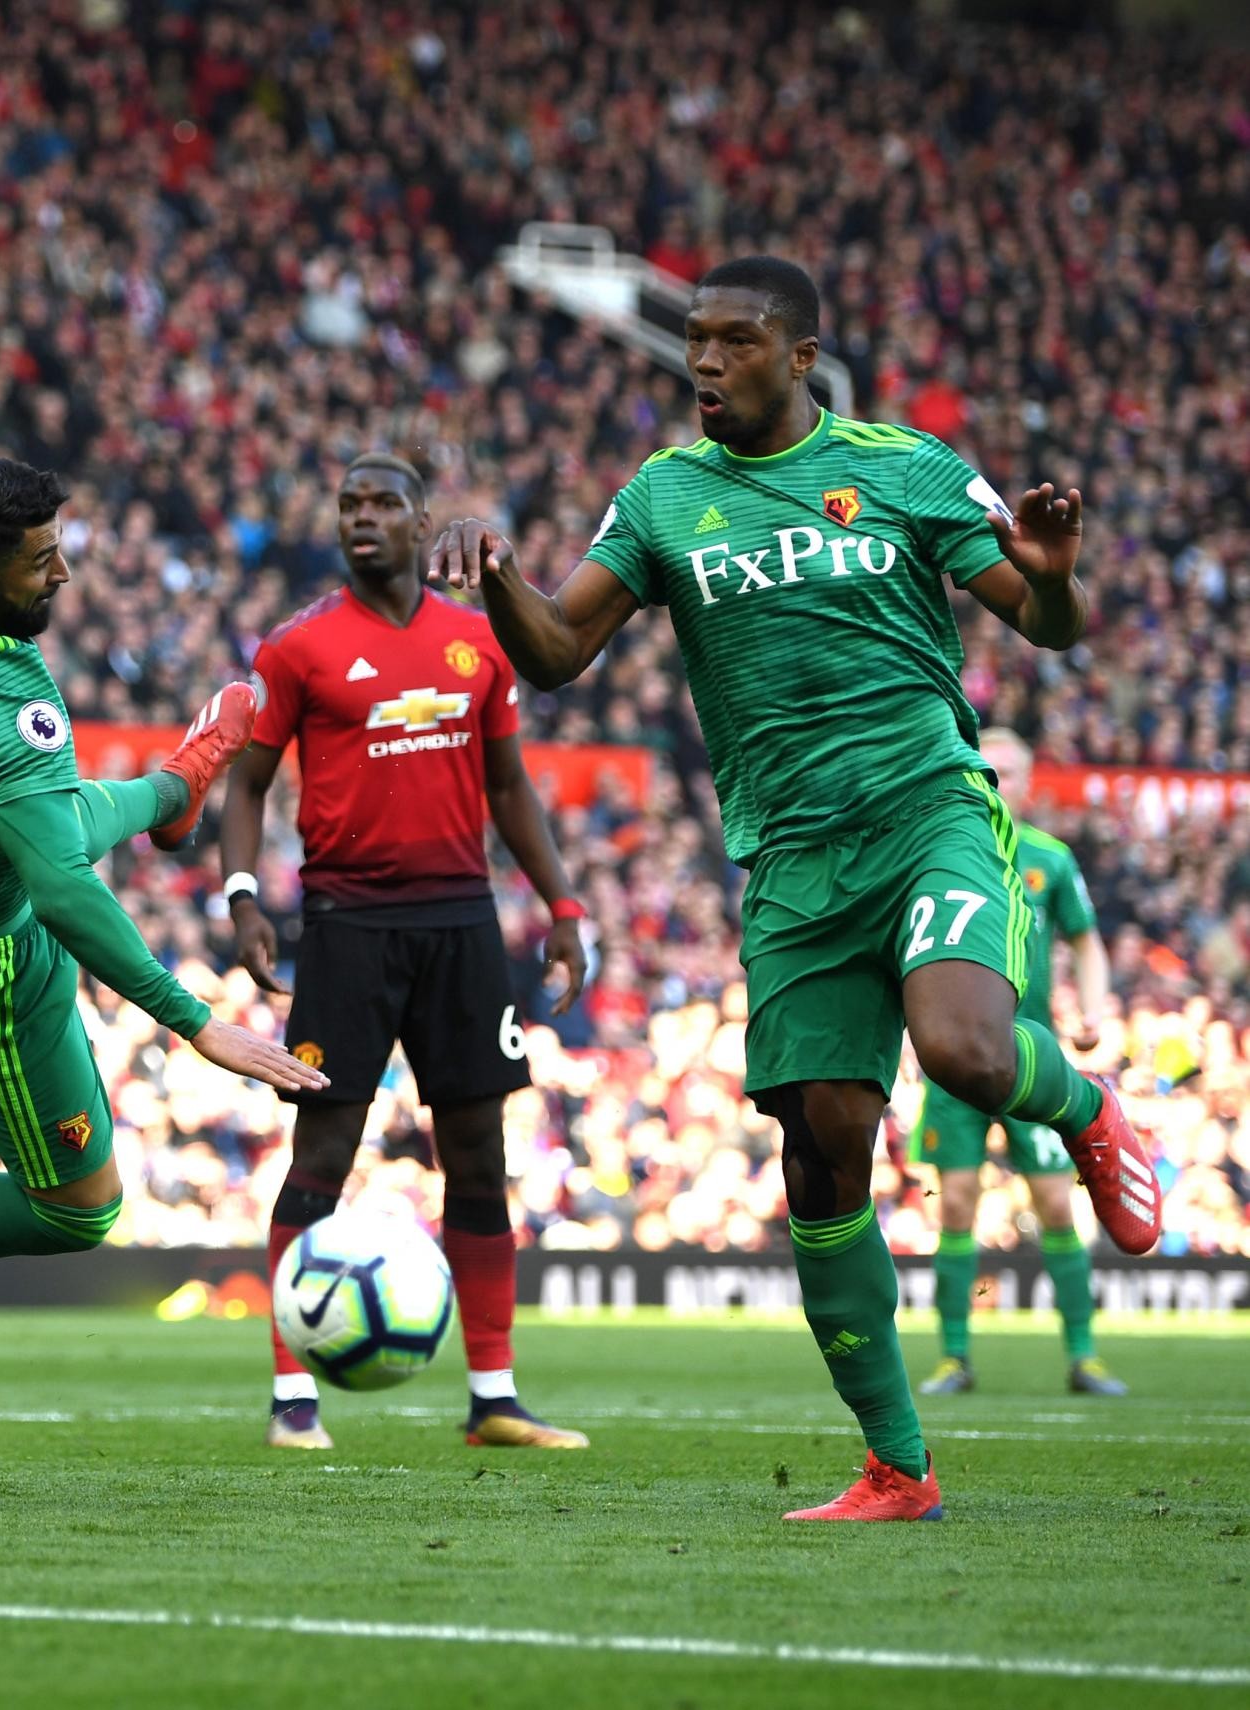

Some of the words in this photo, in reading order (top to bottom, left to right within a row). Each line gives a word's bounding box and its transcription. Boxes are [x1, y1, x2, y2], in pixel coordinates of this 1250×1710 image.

[694, 519, 729, 534] adidas
[685, 526, 896, 606] FxPro
[367, 731, 472, 758] CHEVROLET
[904, 889, 989, 963] 27
[498, 1003, 528, 1061] 6
